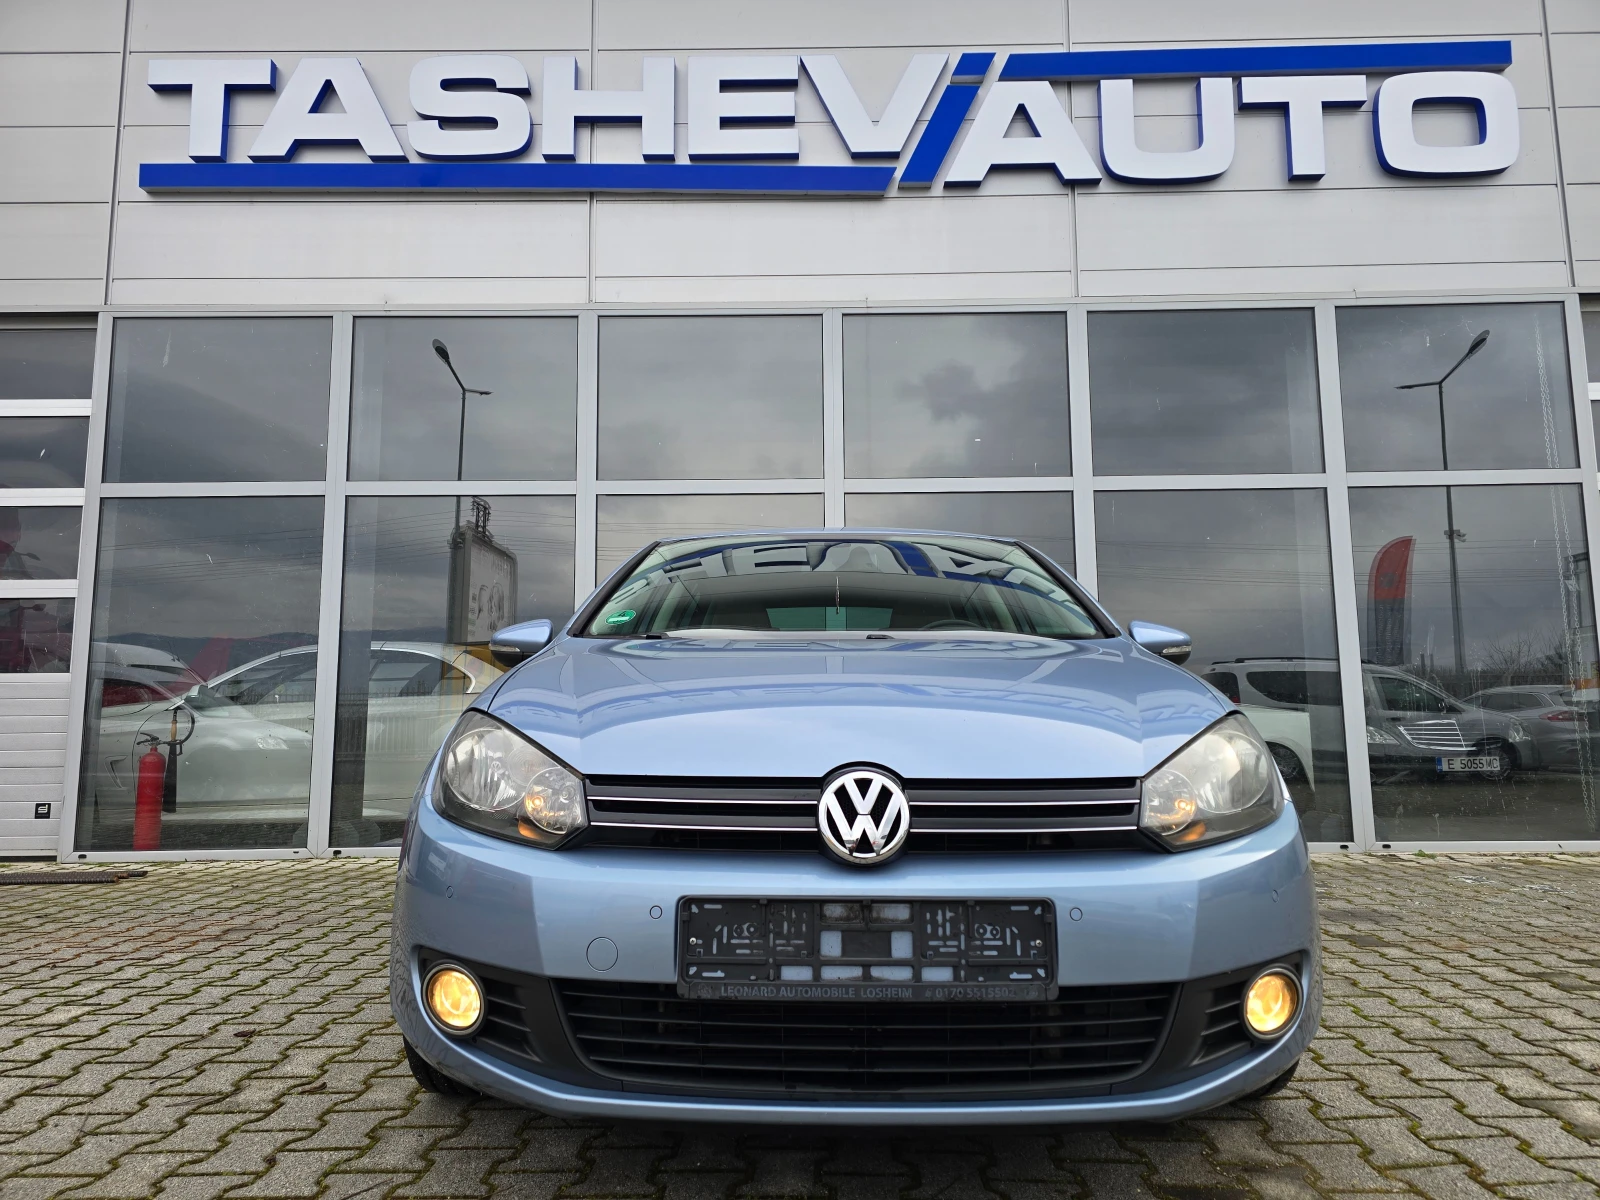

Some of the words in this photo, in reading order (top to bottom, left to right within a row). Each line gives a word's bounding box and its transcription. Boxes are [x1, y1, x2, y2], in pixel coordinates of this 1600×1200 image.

[148, 54, 949, 163] TASHEV
[944, 71, 1520, 188] AUTO
[1460, 758, 1484, 770] 5055
[721, 985, 777, 997] LEONARD
[778, 986, 856, 998] AUTOMOBILE
[860, 987, 913, 998] LOSHEIM
